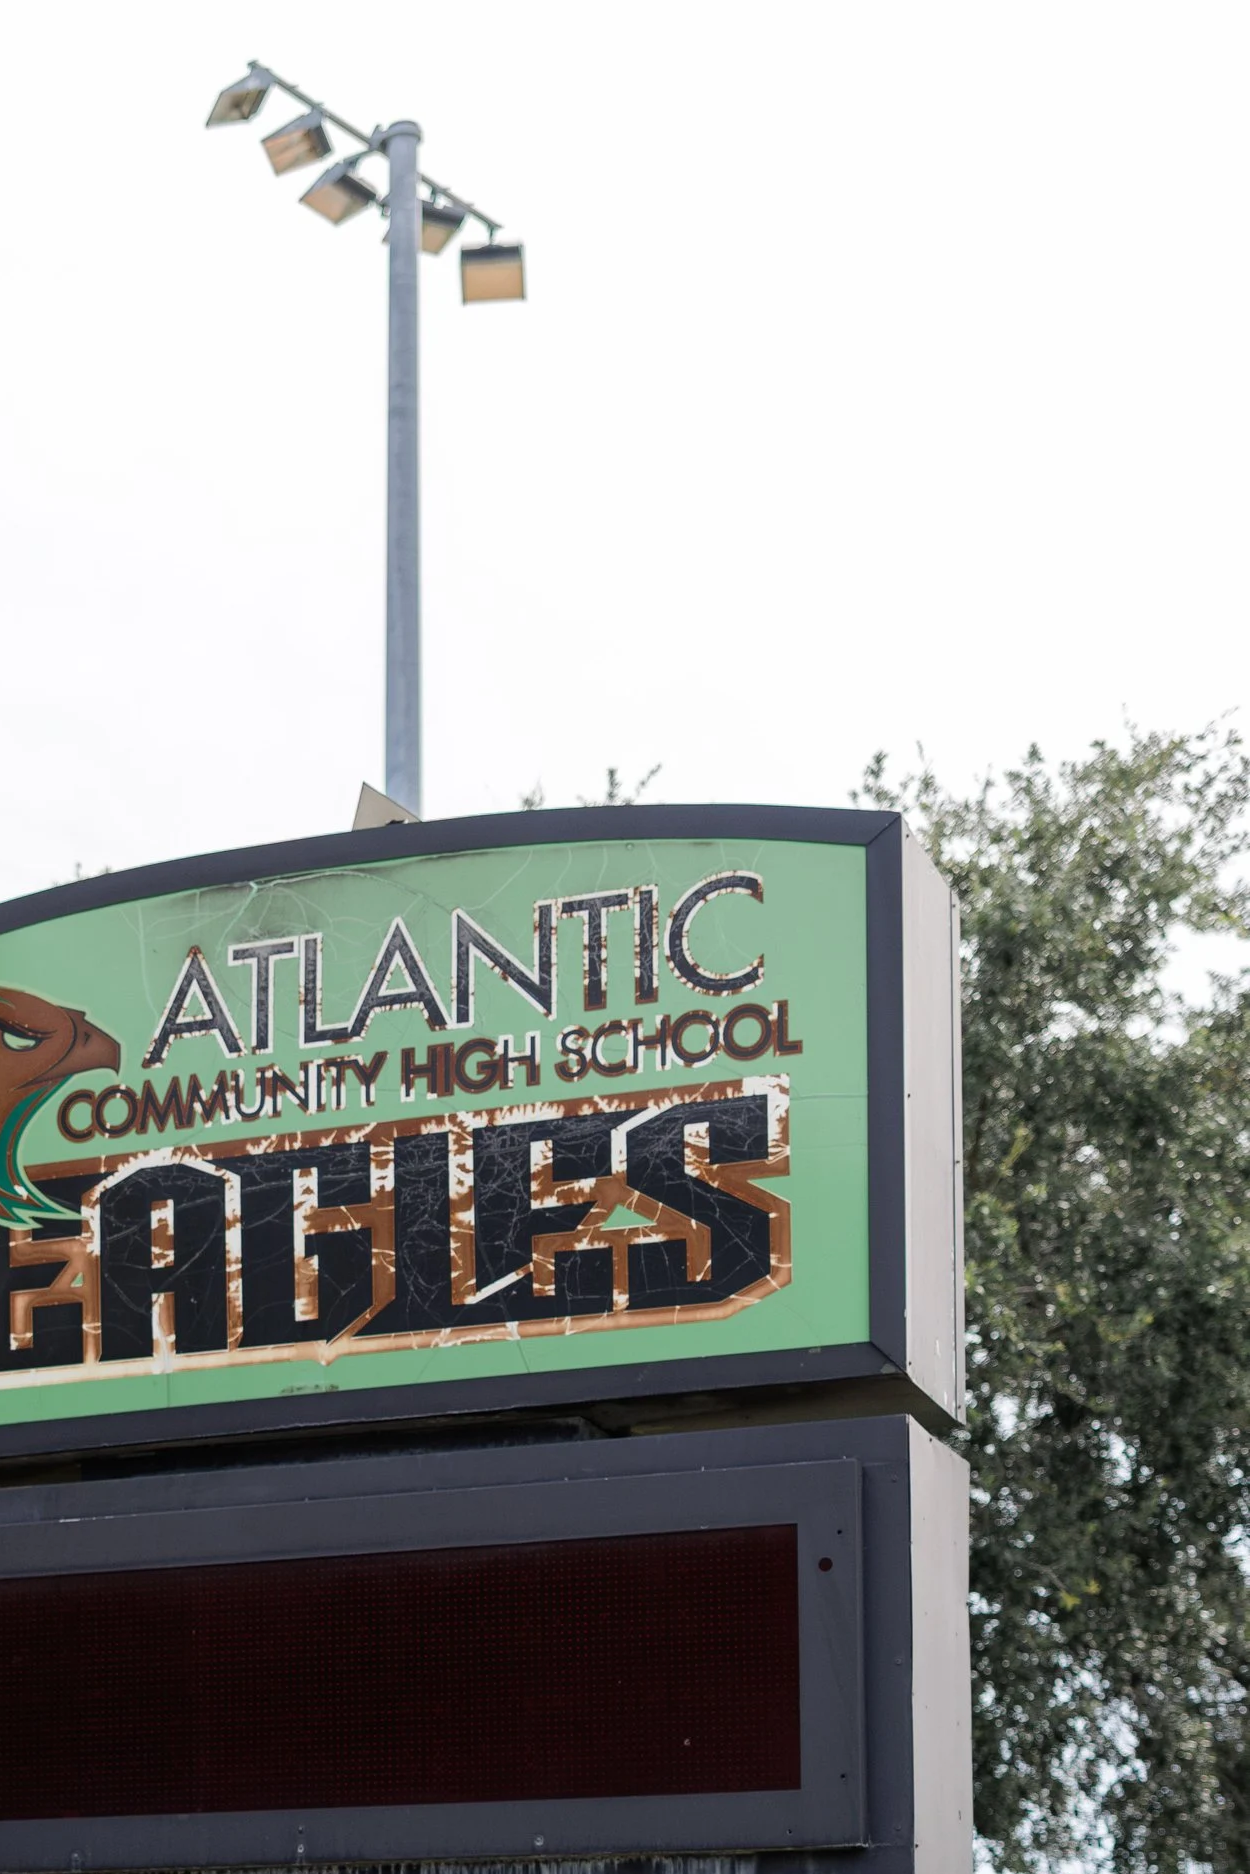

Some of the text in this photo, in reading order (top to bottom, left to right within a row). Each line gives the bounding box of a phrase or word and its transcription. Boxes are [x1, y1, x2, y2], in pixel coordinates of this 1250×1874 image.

[142, 870, 764, 1068] ATLANTIC
[57, 1000, 804, 1143] COMMUNITY HIGH SCHOOL
